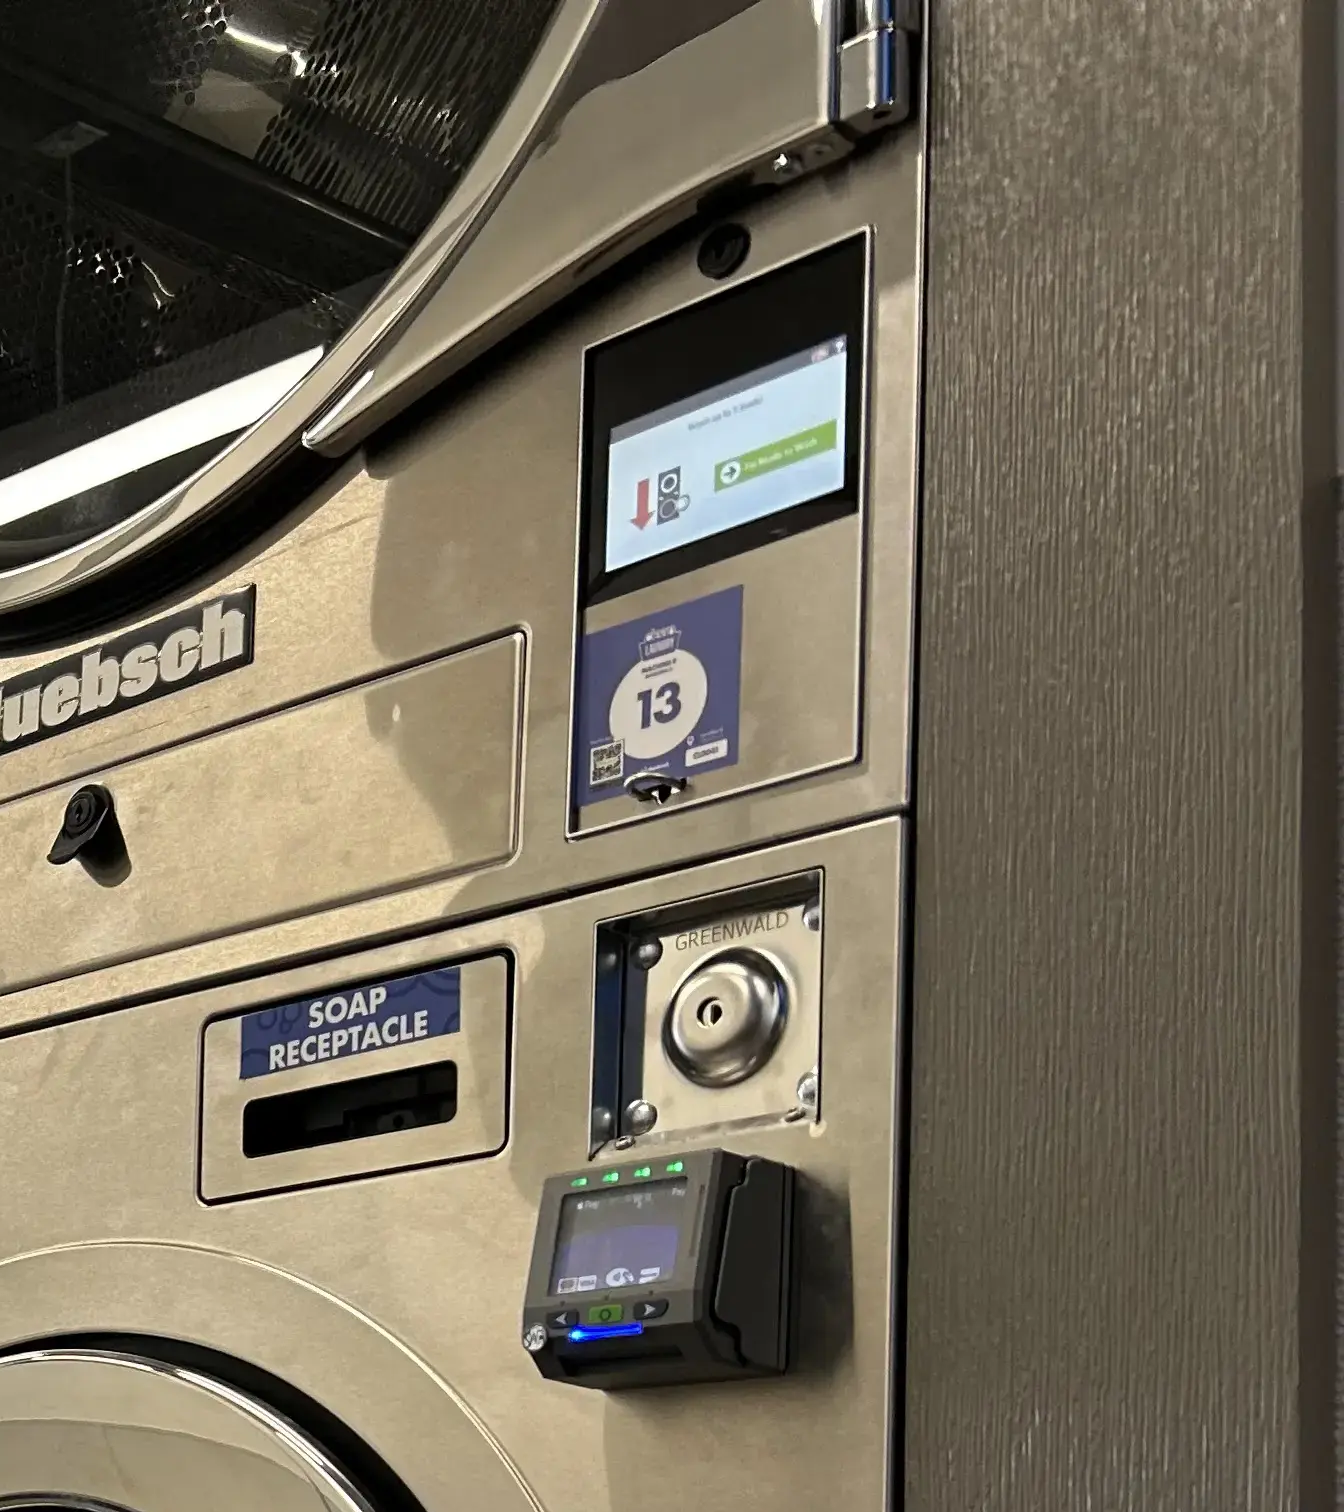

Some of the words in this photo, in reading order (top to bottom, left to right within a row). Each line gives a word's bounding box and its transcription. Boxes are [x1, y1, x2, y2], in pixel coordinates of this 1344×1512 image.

[636, 681, 682, 730] 13
[673, 910, 790, 952] GREENWALD
[308, 985, 388, 1030] SOAP
[267, 1009, 429, 1072] RECEPTACLE
